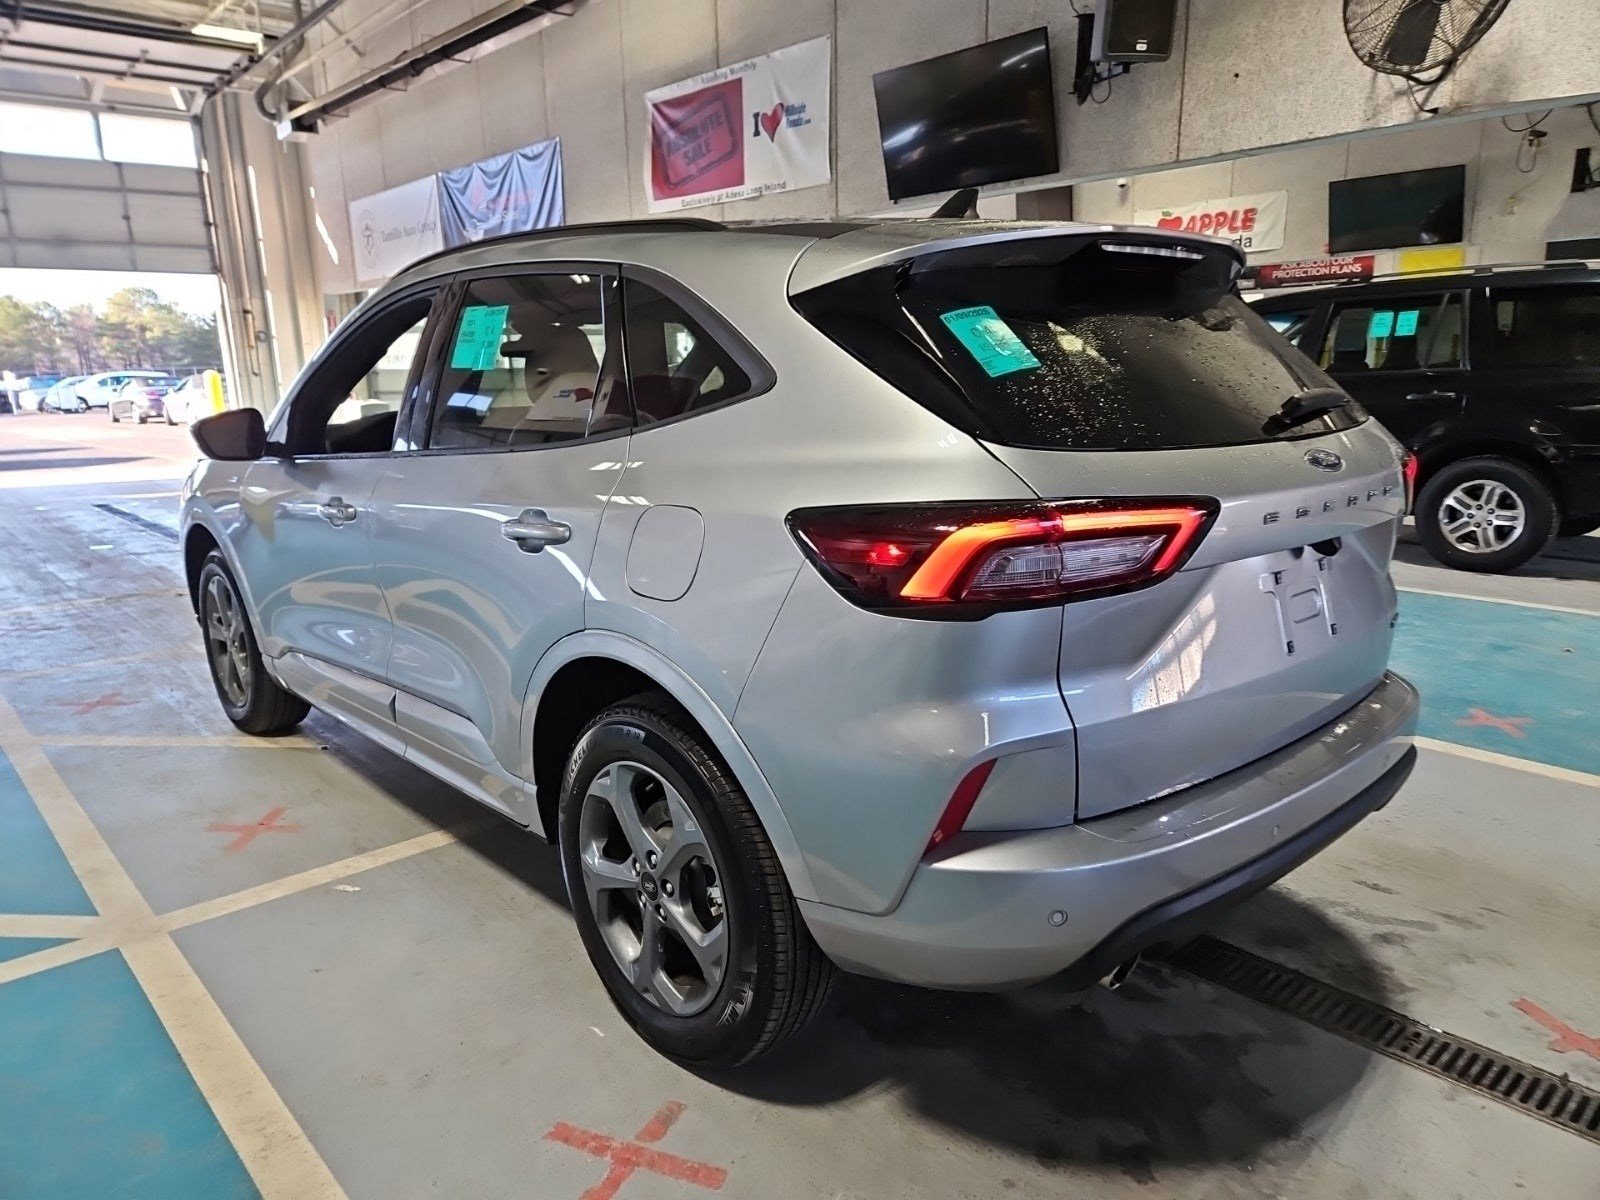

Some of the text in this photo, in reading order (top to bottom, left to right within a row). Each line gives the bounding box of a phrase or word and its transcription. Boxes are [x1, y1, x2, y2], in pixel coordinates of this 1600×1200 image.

[752, 112, 760, 137] I
[684, 137, 712, 166] SALE
[681, 194, 716, 208] Exclusively
[745, 185, 763, 197] Long
[764, 181, 787, 192] Island
[1184, 207, 1259, 236] APPLE
[1271, 263, 1363, 279] PROTECTION PLANS
[1298, 258, 1330, 268] ABOUT
